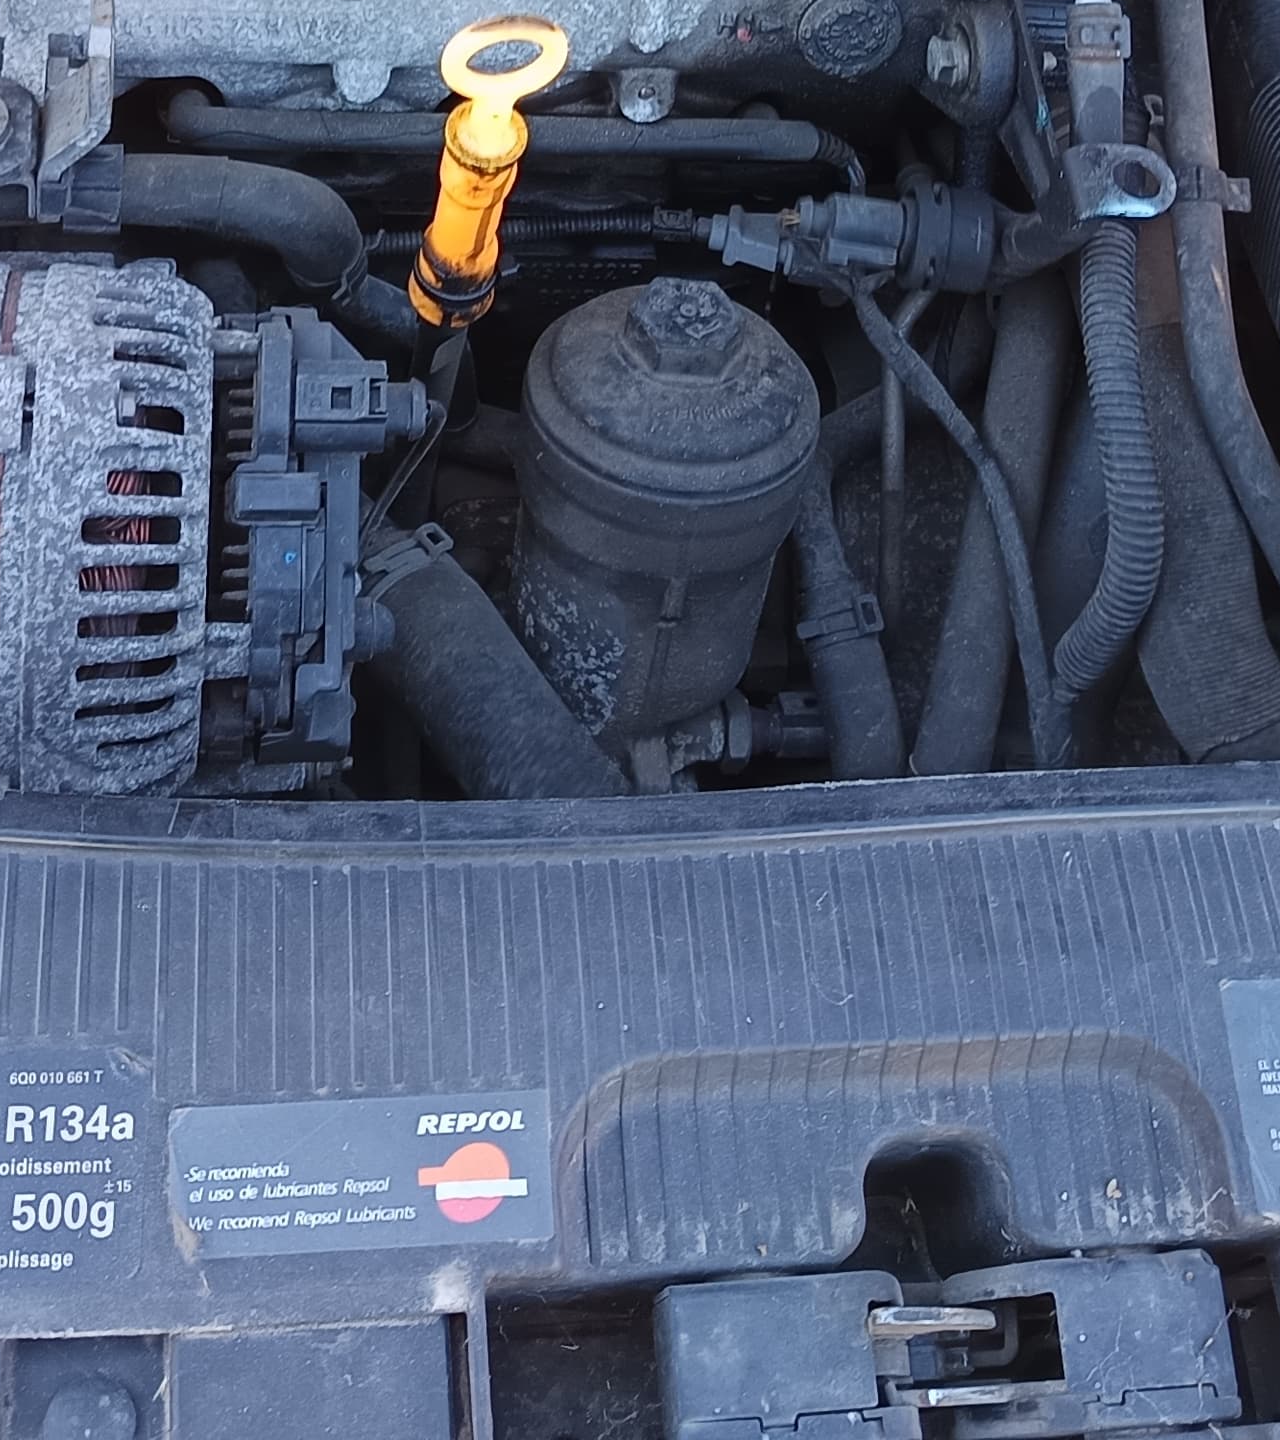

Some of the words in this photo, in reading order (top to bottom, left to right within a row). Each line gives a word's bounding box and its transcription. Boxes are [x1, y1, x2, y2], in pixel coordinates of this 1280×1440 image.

[9, 1072, 37, 1085] 6Q0
[39, 1071, 63, 1084] 010
[67, 1071, 90, 1084] 661
[94, 1070, 104, 1083] T
[1258, 1060, 1270, 1071] EL
[5, 1104, 135, 1143] R134a
[417, 1110, 526, 1136] REPSOL
[207, 1161, 290, 1181] recomienda
[189, 1186, 203, 1203] el
[208, 1188, 234, 1202] uso
[239, 1184, 259, 1200] de
[263, 1180, 337, 1199] lubricantes
[343, 1176, 391, 1196] Repsol
[11, 1191, 115, 1239] 500g
[189, 1217, 214, 1231] We
[218, 1212, 289, 1230] recomend
[294, 1209, 341, 1228] Repsol
[346, 1205, 416, 1224] Lubricants
